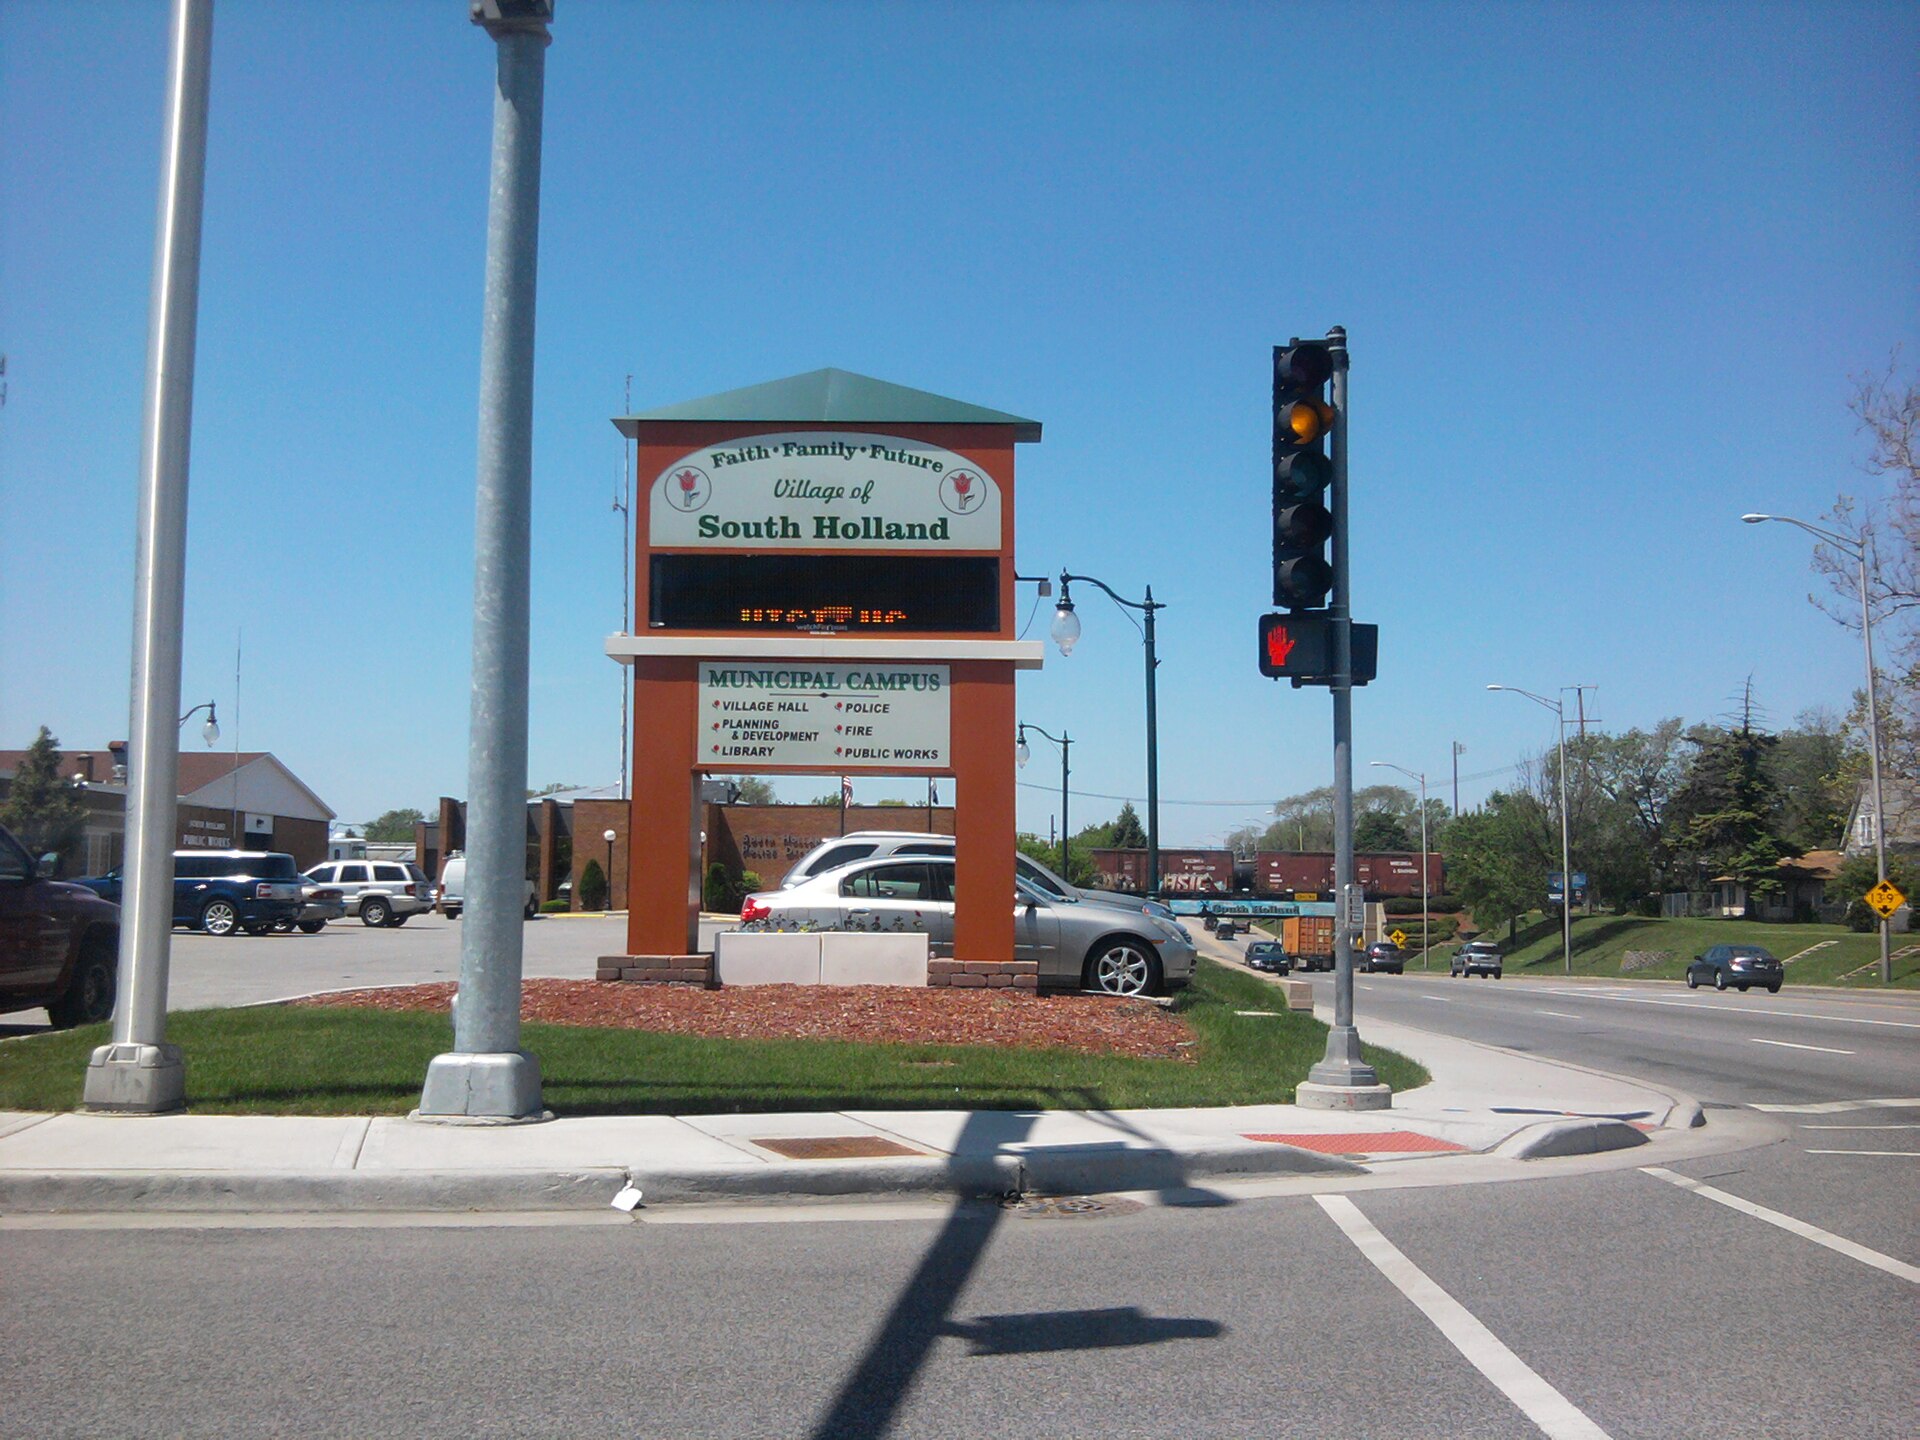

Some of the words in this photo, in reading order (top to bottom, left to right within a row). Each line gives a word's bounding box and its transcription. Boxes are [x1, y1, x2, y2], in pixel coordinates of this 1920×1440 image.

[711, 446, 770, 469] Faith
[782, 442, 857, 462] Family
[870, 444, 944, 473] Future
[773, 479, 845, 504] Village
[849, 480, 874, 503] of
[698, 515, 801, 539] South
[813, 516, 950, 540] Holland
[708, 670, 841, 690] MUNICIPAL
[846, 672, 941, 692] CAMPUS
[722, 701, 774, 712] VILLAGE
[777, 702, 809, 713] HALL
[845, 703, 890, 714] POLICE
[722, 719, 780, 730] PLANNING
[731, 730, 740, 741] &
[742, 731, 819, 742] DEVELOPMENT
[845, 726, 873, 737] FIRE
[722, 746, 775, 757] LIBRARY
[845, 748, 890, 759] PUBLIC
[894, 749, 939, 760] WORKS
